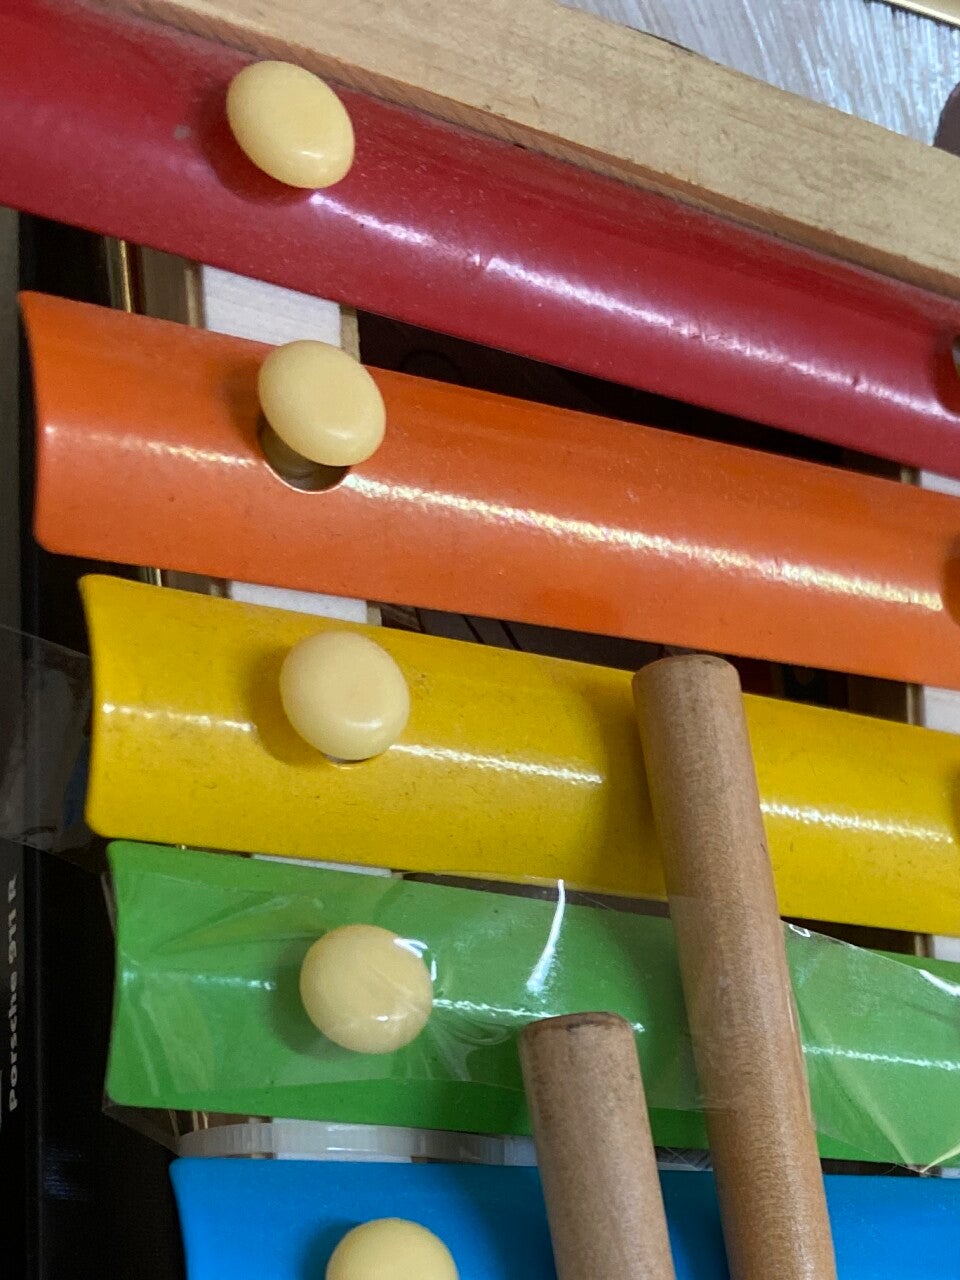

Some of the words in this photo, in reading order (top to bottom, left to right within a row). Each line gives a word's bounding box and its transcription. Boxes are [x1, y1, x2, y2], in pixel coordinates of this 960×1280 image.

[7, 873, 17, 903] R
[7, 908, 17, 965] 911
[8, 971, 18, 1112] Porsche
